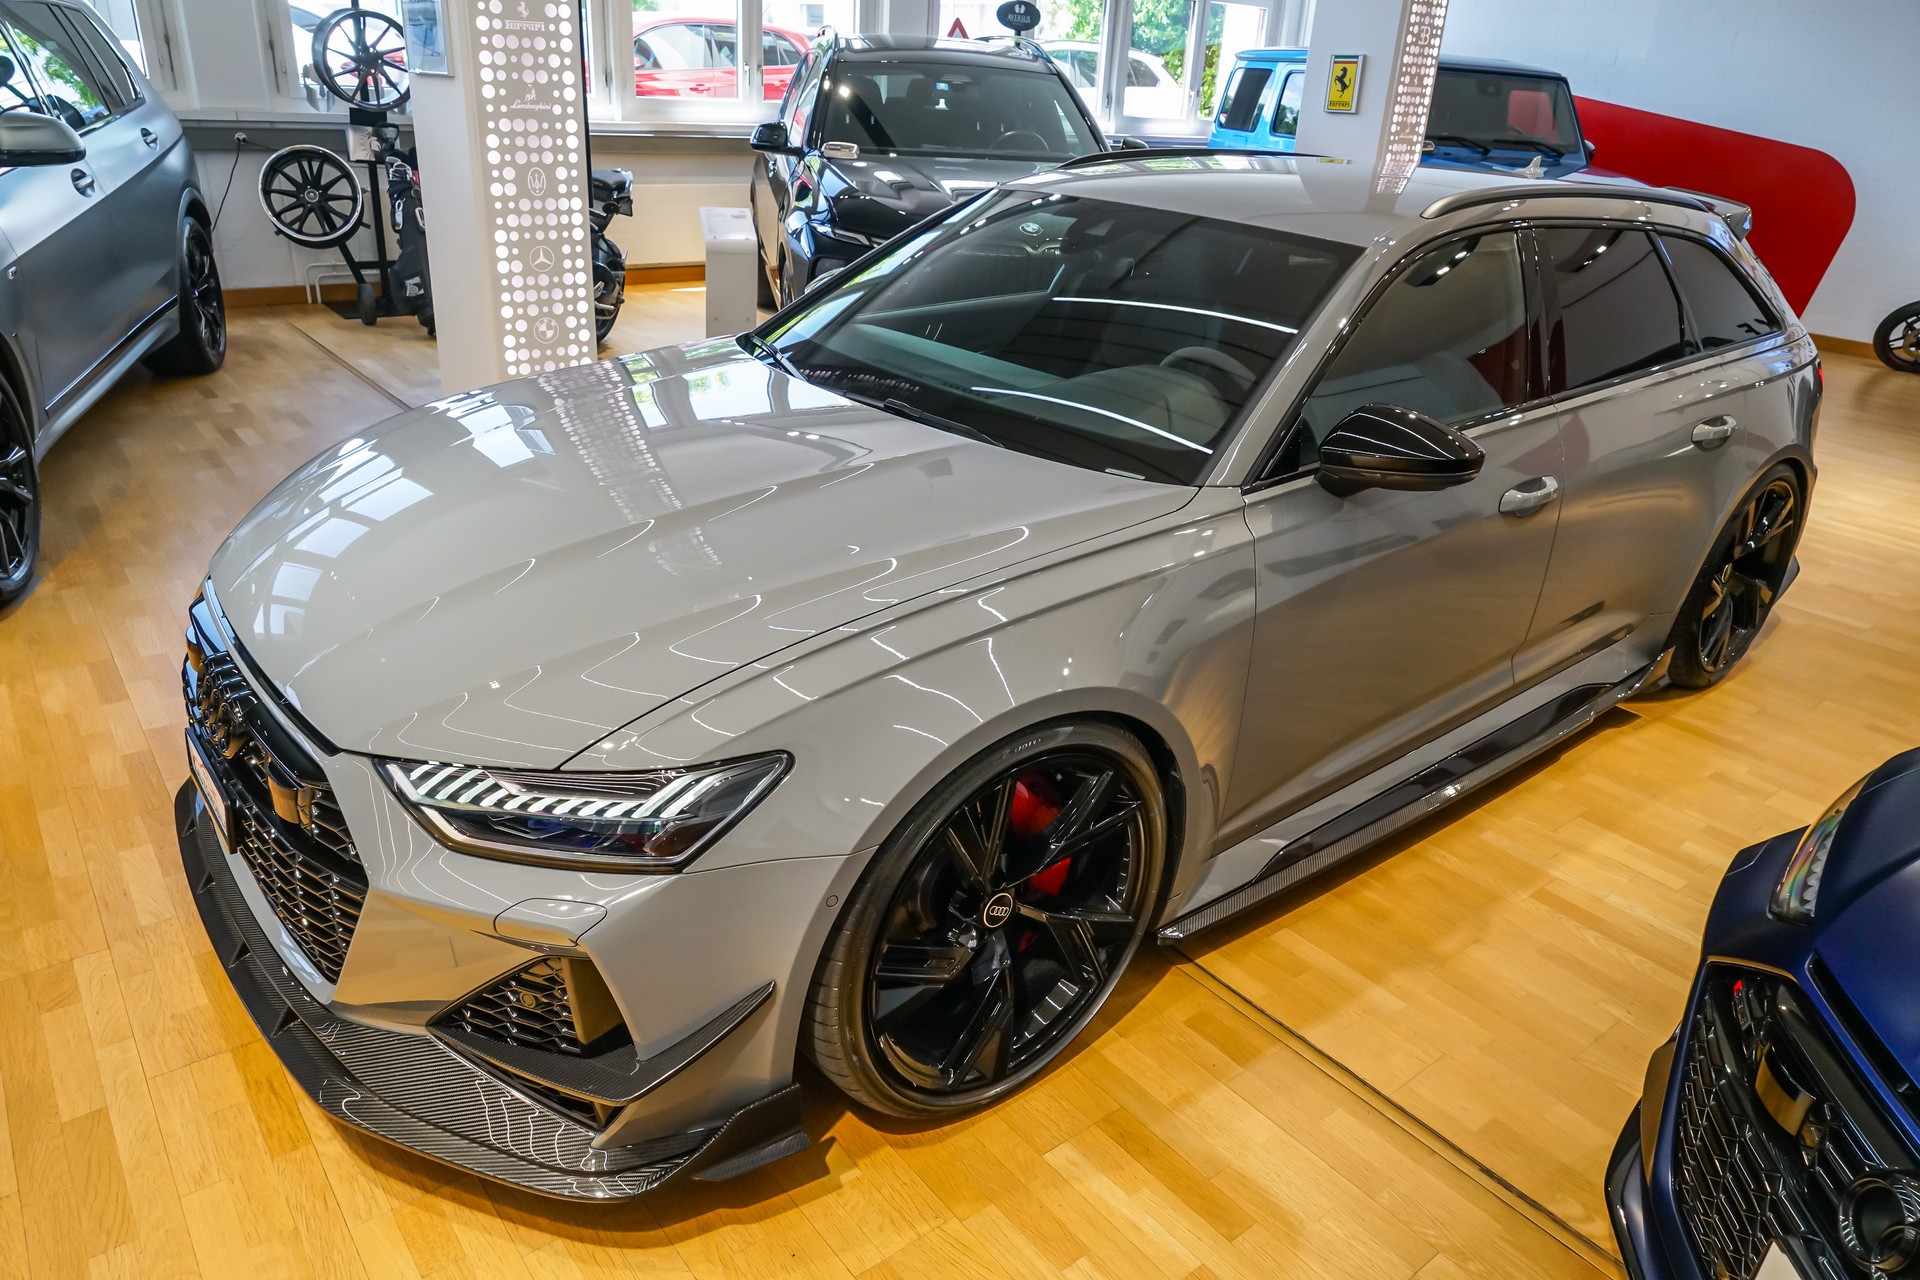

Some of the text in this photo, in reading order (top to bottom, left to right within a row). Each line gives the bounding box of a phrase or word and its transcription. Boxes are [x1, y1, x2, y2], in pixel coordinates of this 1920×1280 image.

[504, 20, 545, 31] Ferrari
[510, 99, 552, 111] Lamborghini
[1329, 100, 1350, 108] Ferrari
